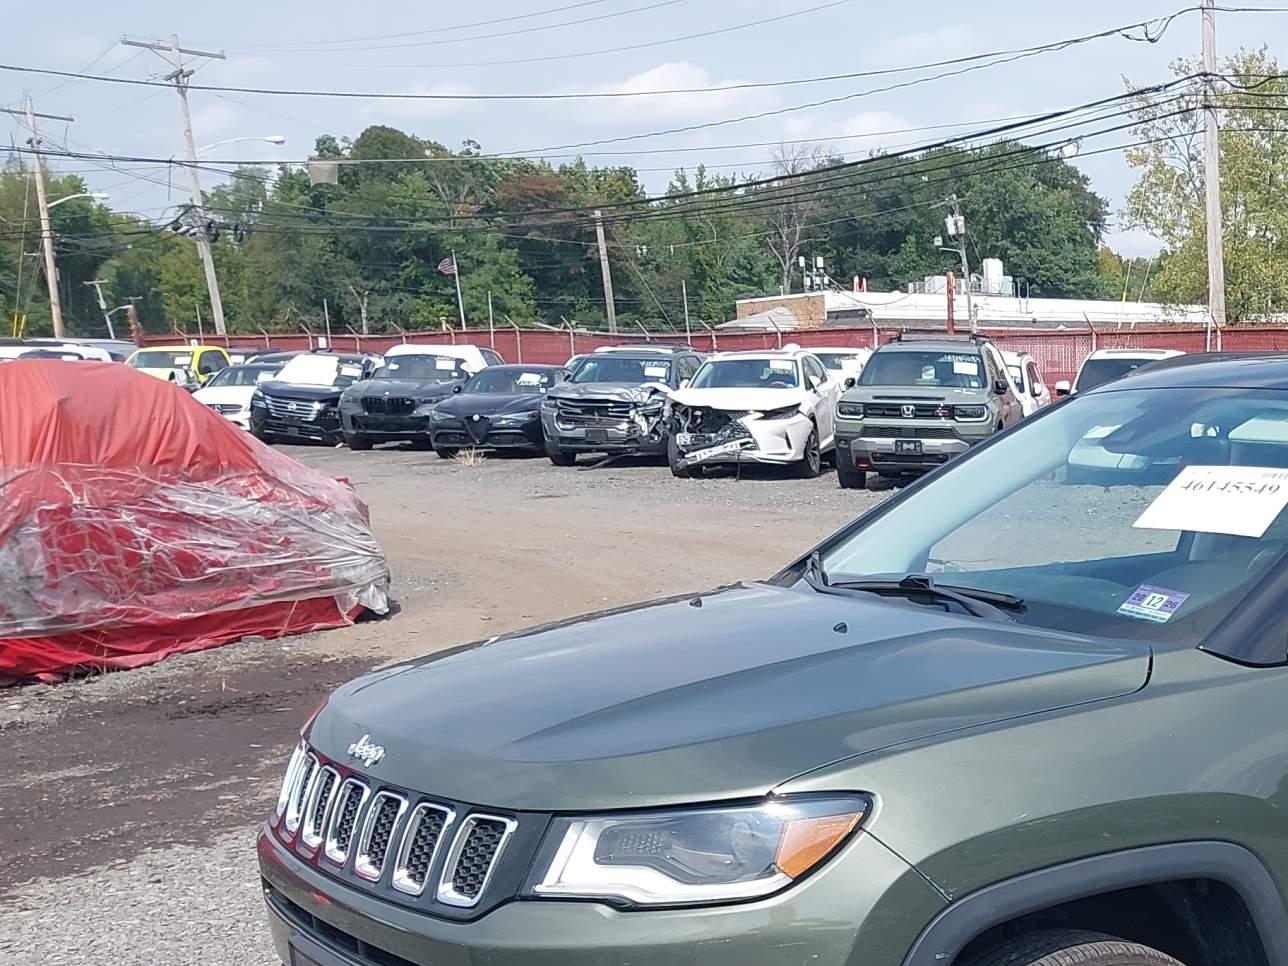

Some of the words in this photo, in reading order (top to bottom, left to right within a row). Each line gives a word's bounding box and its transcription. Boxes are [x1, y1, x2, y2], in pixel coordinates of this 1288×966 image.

[1131, 593, 1146, 602] 20
[1146, 595, 1164, 608] 12
[1164, 600, 1179, 609] 26
[347, 733, 386, 768] Jeep
